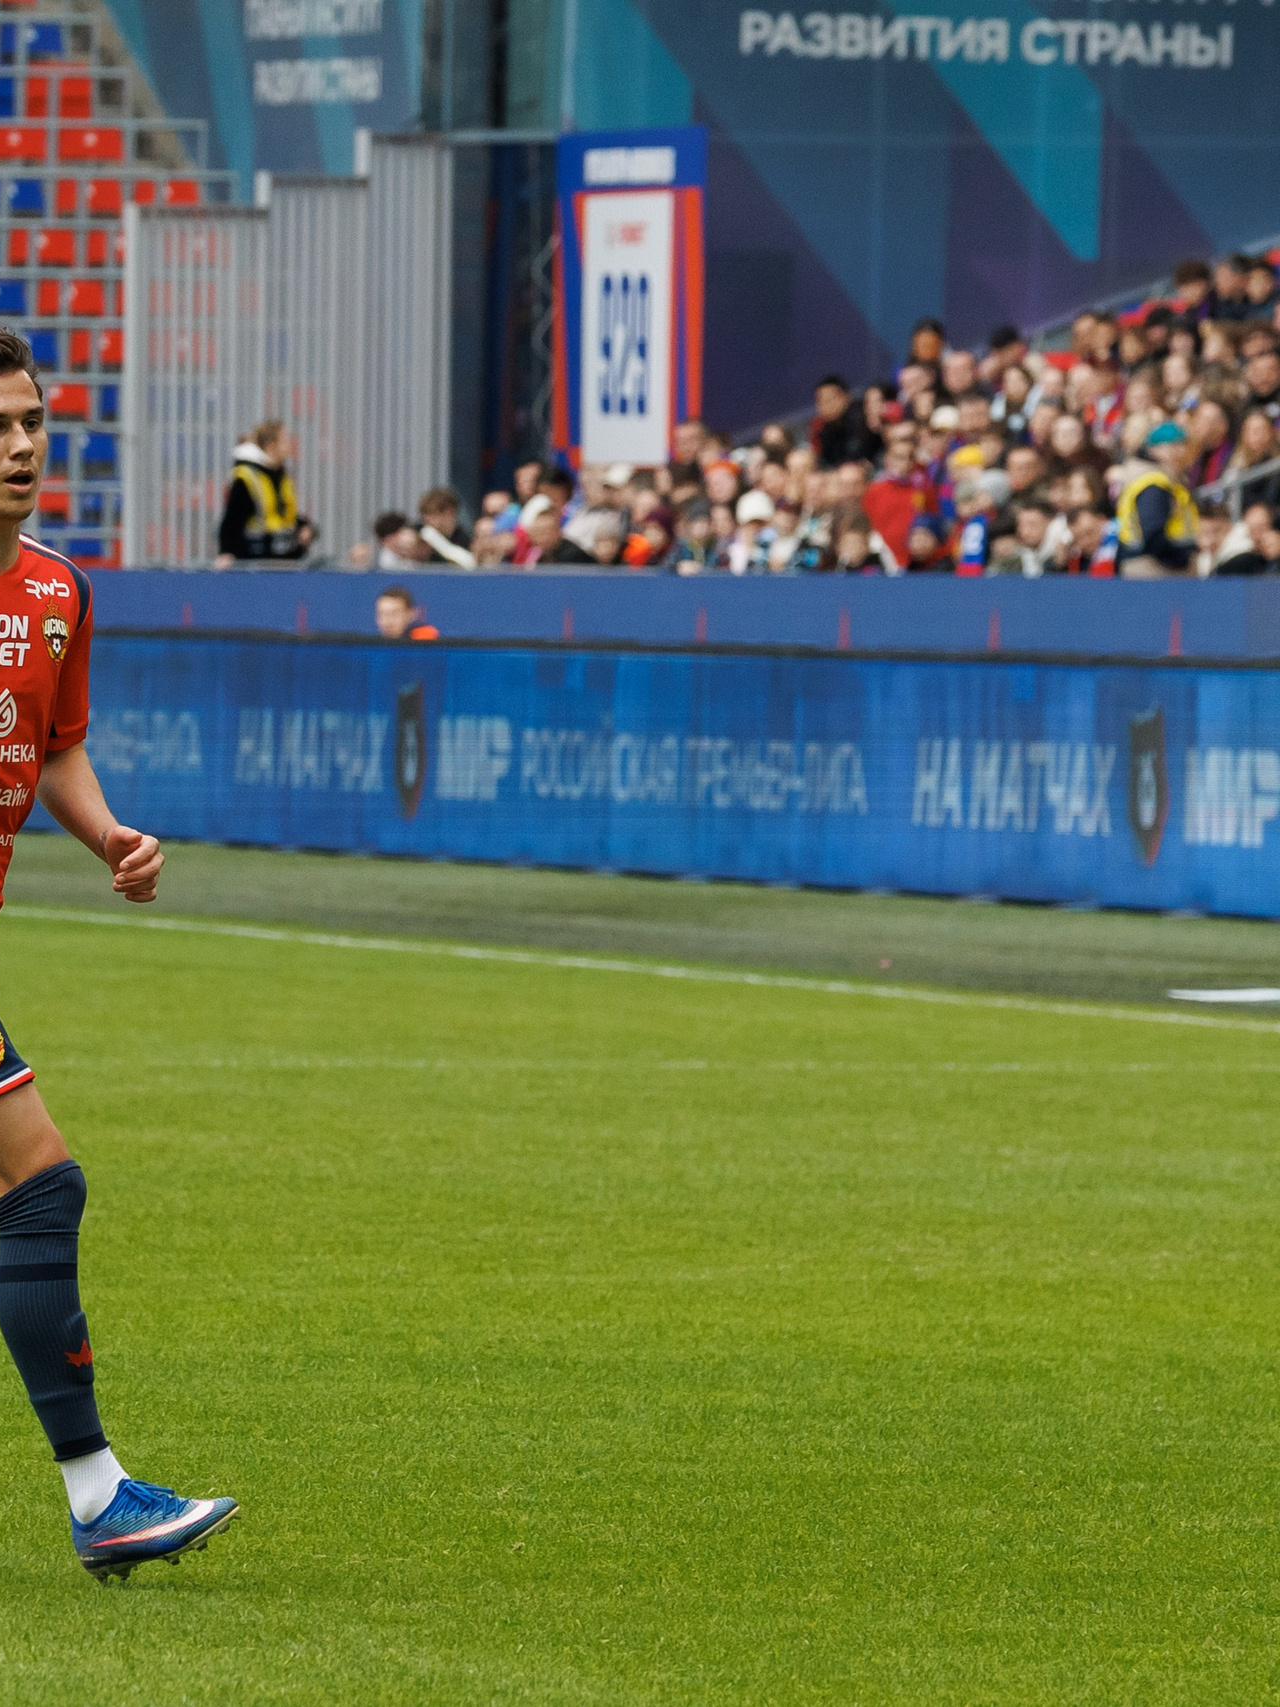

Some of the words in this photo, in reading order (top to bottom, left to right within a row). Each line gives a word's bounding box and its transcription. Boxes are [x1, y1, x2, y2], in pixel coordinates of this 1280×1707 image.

[739, 11, 1010, 64] РАЗВИТИЯ
[1022, 19, 1234, 69] СТРАНЫ
[44, 618, 68, 636] ЦСКА
[911, 737, 963, 828] НА
[968, 739, 1116, 837] МАТЧАХ
